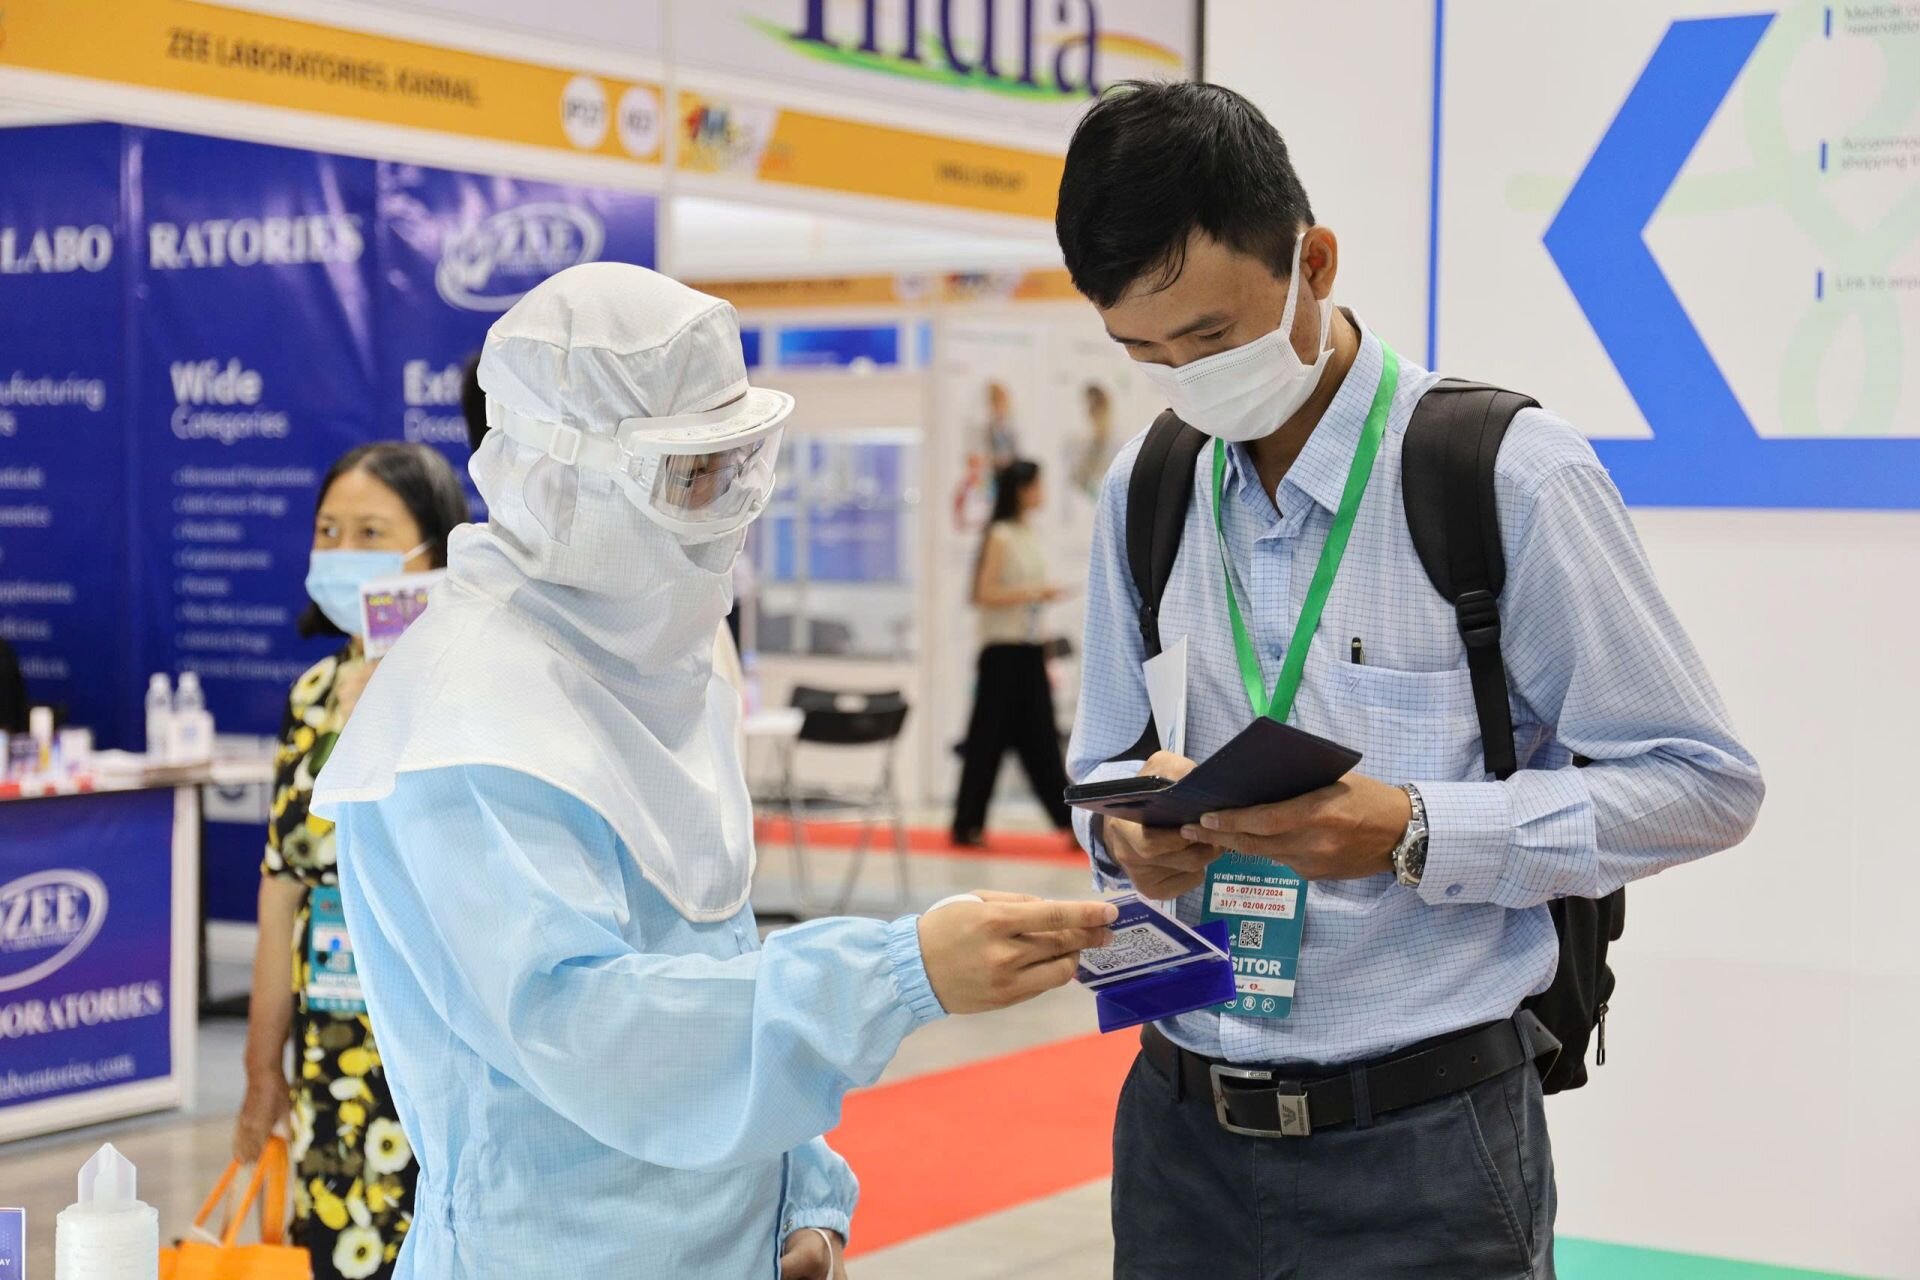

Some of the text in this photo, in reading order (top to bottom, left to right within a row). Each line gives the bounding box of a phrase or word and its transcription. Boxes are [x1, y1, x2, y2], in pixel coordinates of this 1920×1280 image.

[166, 26, 210, 63] ZEE
[0, 214, 365, 274] LABO RATORIES
[170, 357, 263, 406] Wide
[170, 403, 291, 446] Categories
[1240, 886, 1283, 897] 07/12/2024
[1264, 877, 1278, 885] NEXT
[1278, 878, 1300, 886] EVENTS
[1, 884, 84, 939] ZEE
[1220, 899, 1237, 907] 31/7
[1242, 901, 1286, 911] 02/08/2025
